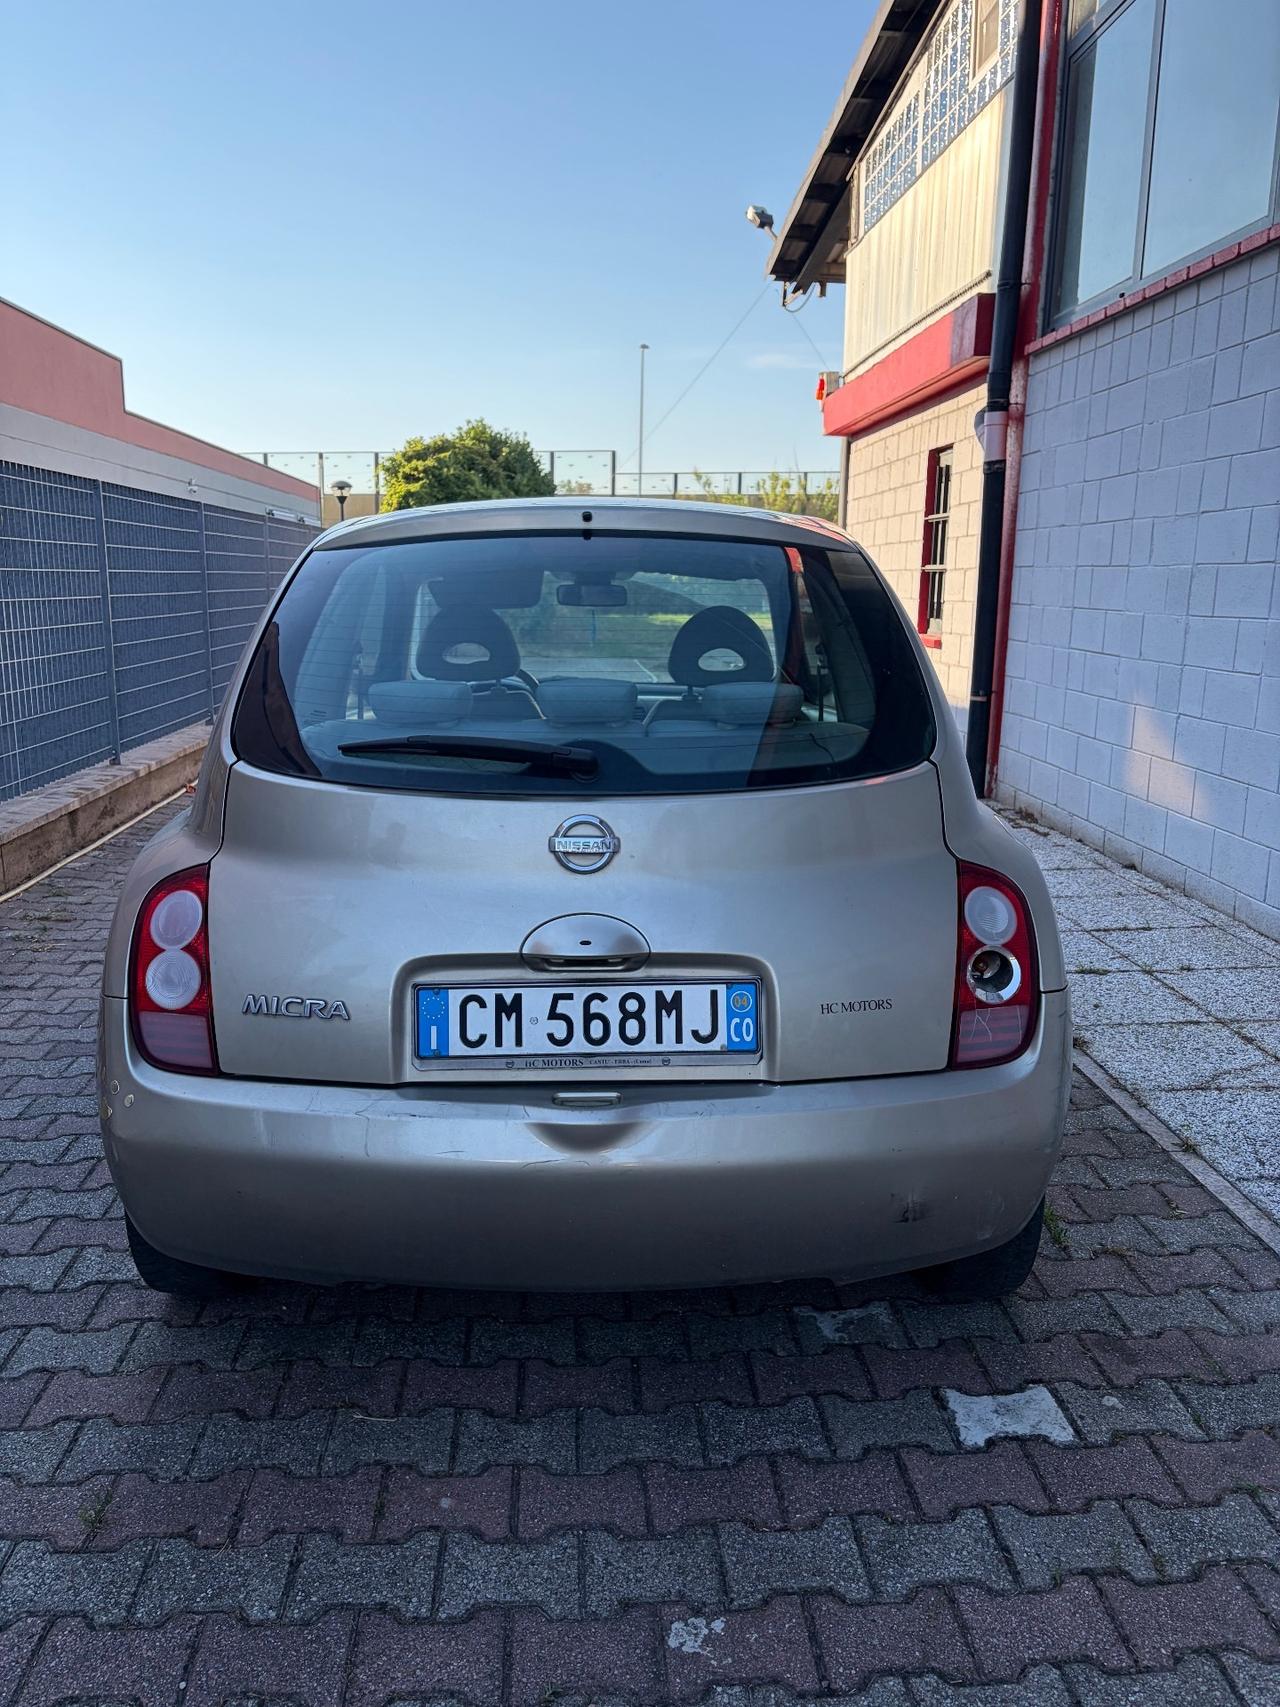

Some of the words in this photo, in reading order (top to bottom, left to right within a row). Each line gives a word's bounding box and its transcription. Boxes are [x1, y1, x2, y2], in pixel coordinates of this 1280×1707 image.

[556, 840, 612, 850] NISSAN
[242, 994, 350, 1020] MICRA
[820, 1002, 839, 1014] HC
[841, 998, 893, 1013] MOTORS
[459, 992, 523, 1049] CM
[730, 1017, 754, 1042] CO
[431, 1025, 437, 1050] I
[542, 1058, 584, 1067] MOTORS
